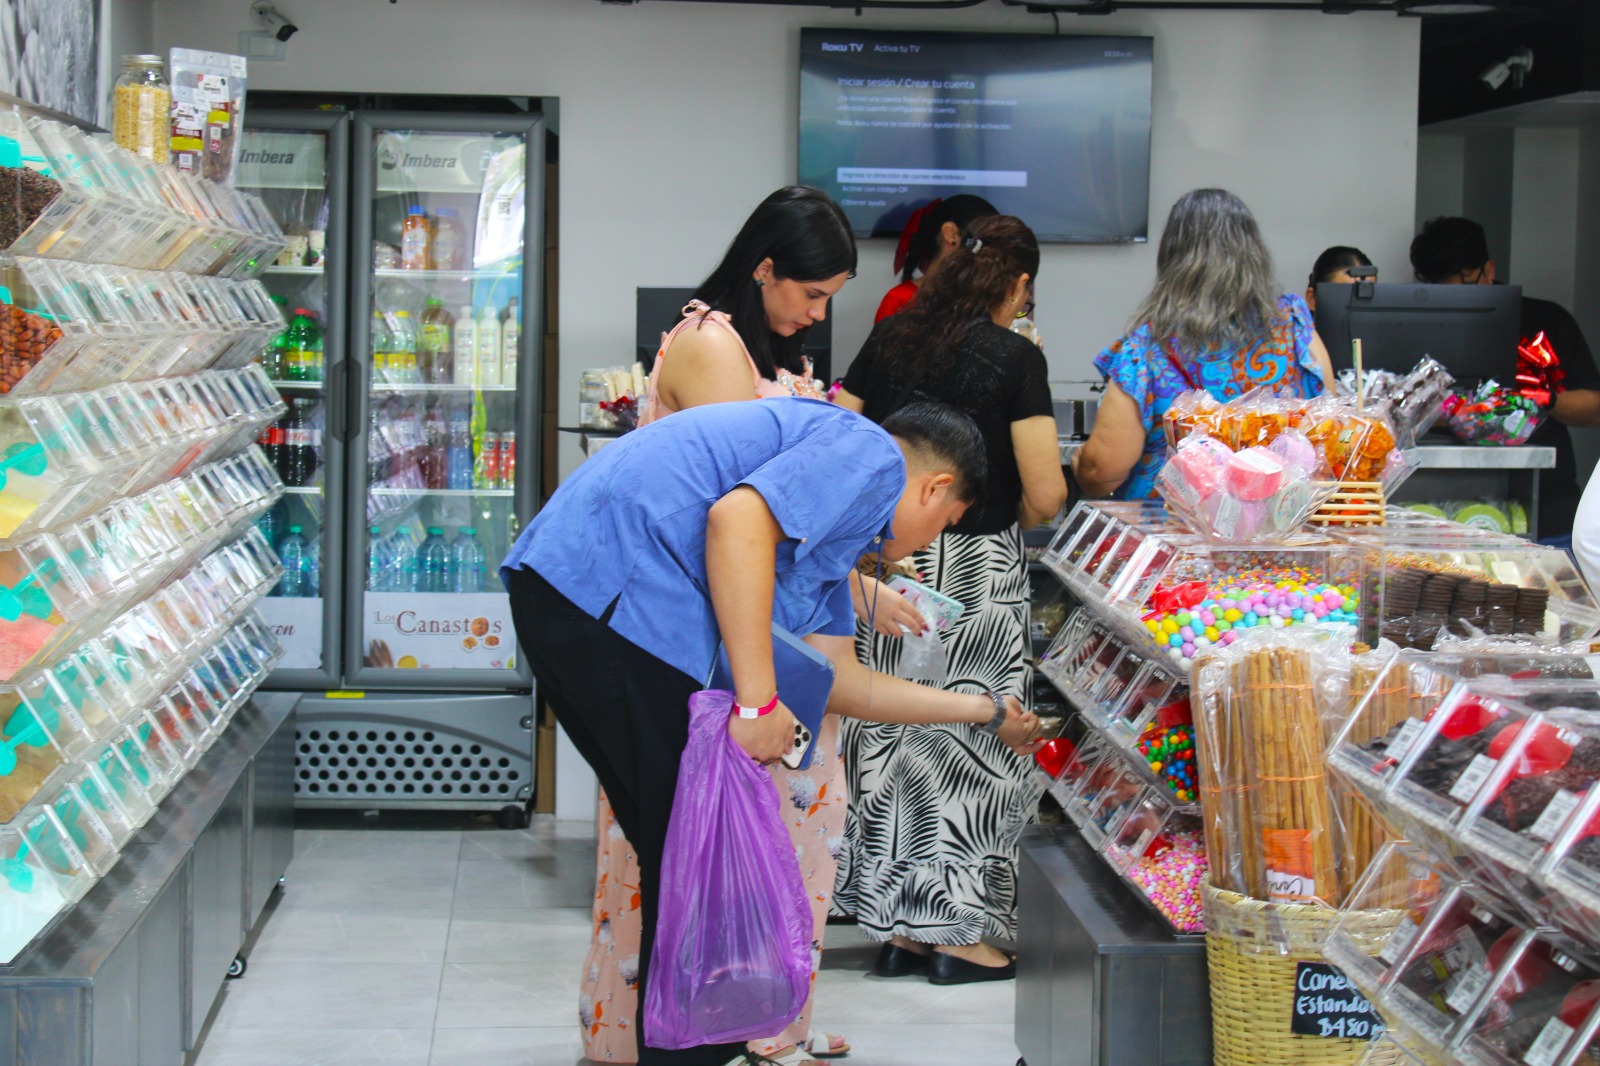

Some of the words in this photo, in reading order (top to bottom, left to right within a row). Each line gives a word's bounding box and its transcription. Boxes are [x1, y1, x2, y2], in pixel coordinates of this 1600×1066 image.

[849, 43, 864, 52] TV
[909, 45, 920, 54] TV
[837, 77, 864, 86] Iniciar
[867, 77, 896, 88] sesión
[904, 79, 929, 89] Crear
[932, 79, 942, 89] tu
[944, 80, 975, 90] cuenta
[239, 148, 295, 165] Imbera
[402, 153, 456, 169] Imbera
